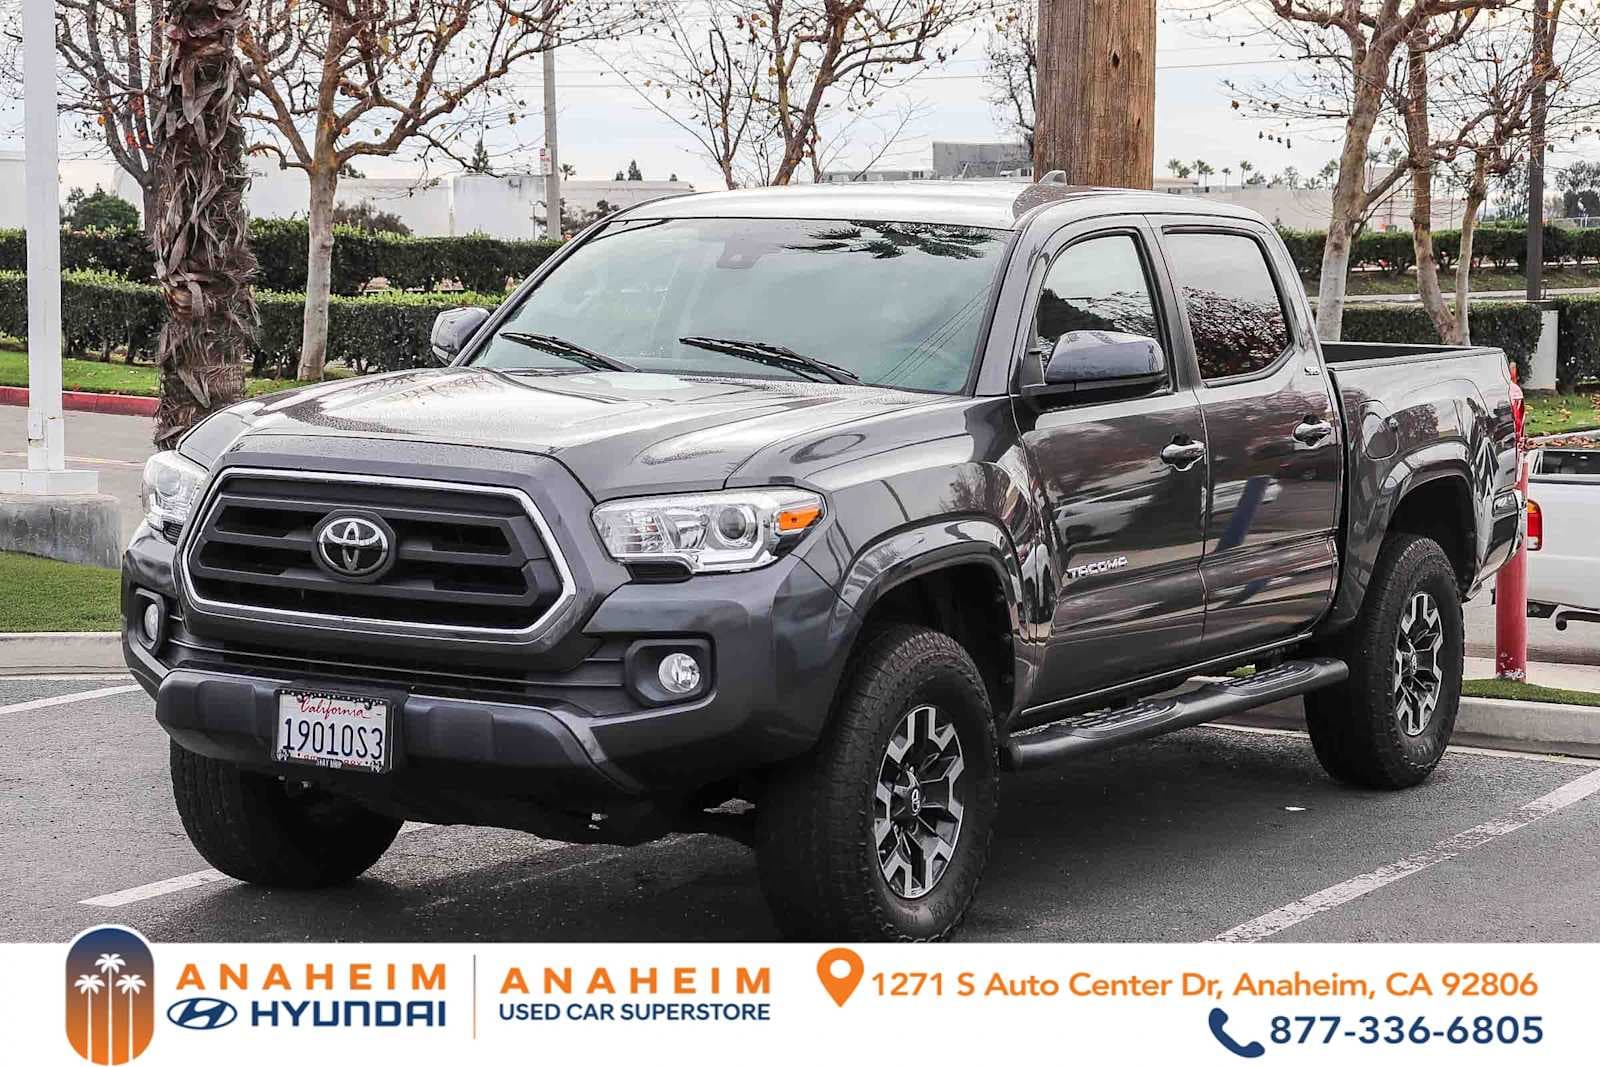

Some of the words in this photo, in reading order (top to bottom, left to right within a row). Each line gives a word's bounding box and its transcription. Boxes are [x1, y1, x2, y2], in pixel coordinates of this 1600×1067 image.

[1066, 556, 1128, 578] TACOMA
[300, 693, 371, 720] California
[282, 718, 383, 760] 19010S3
